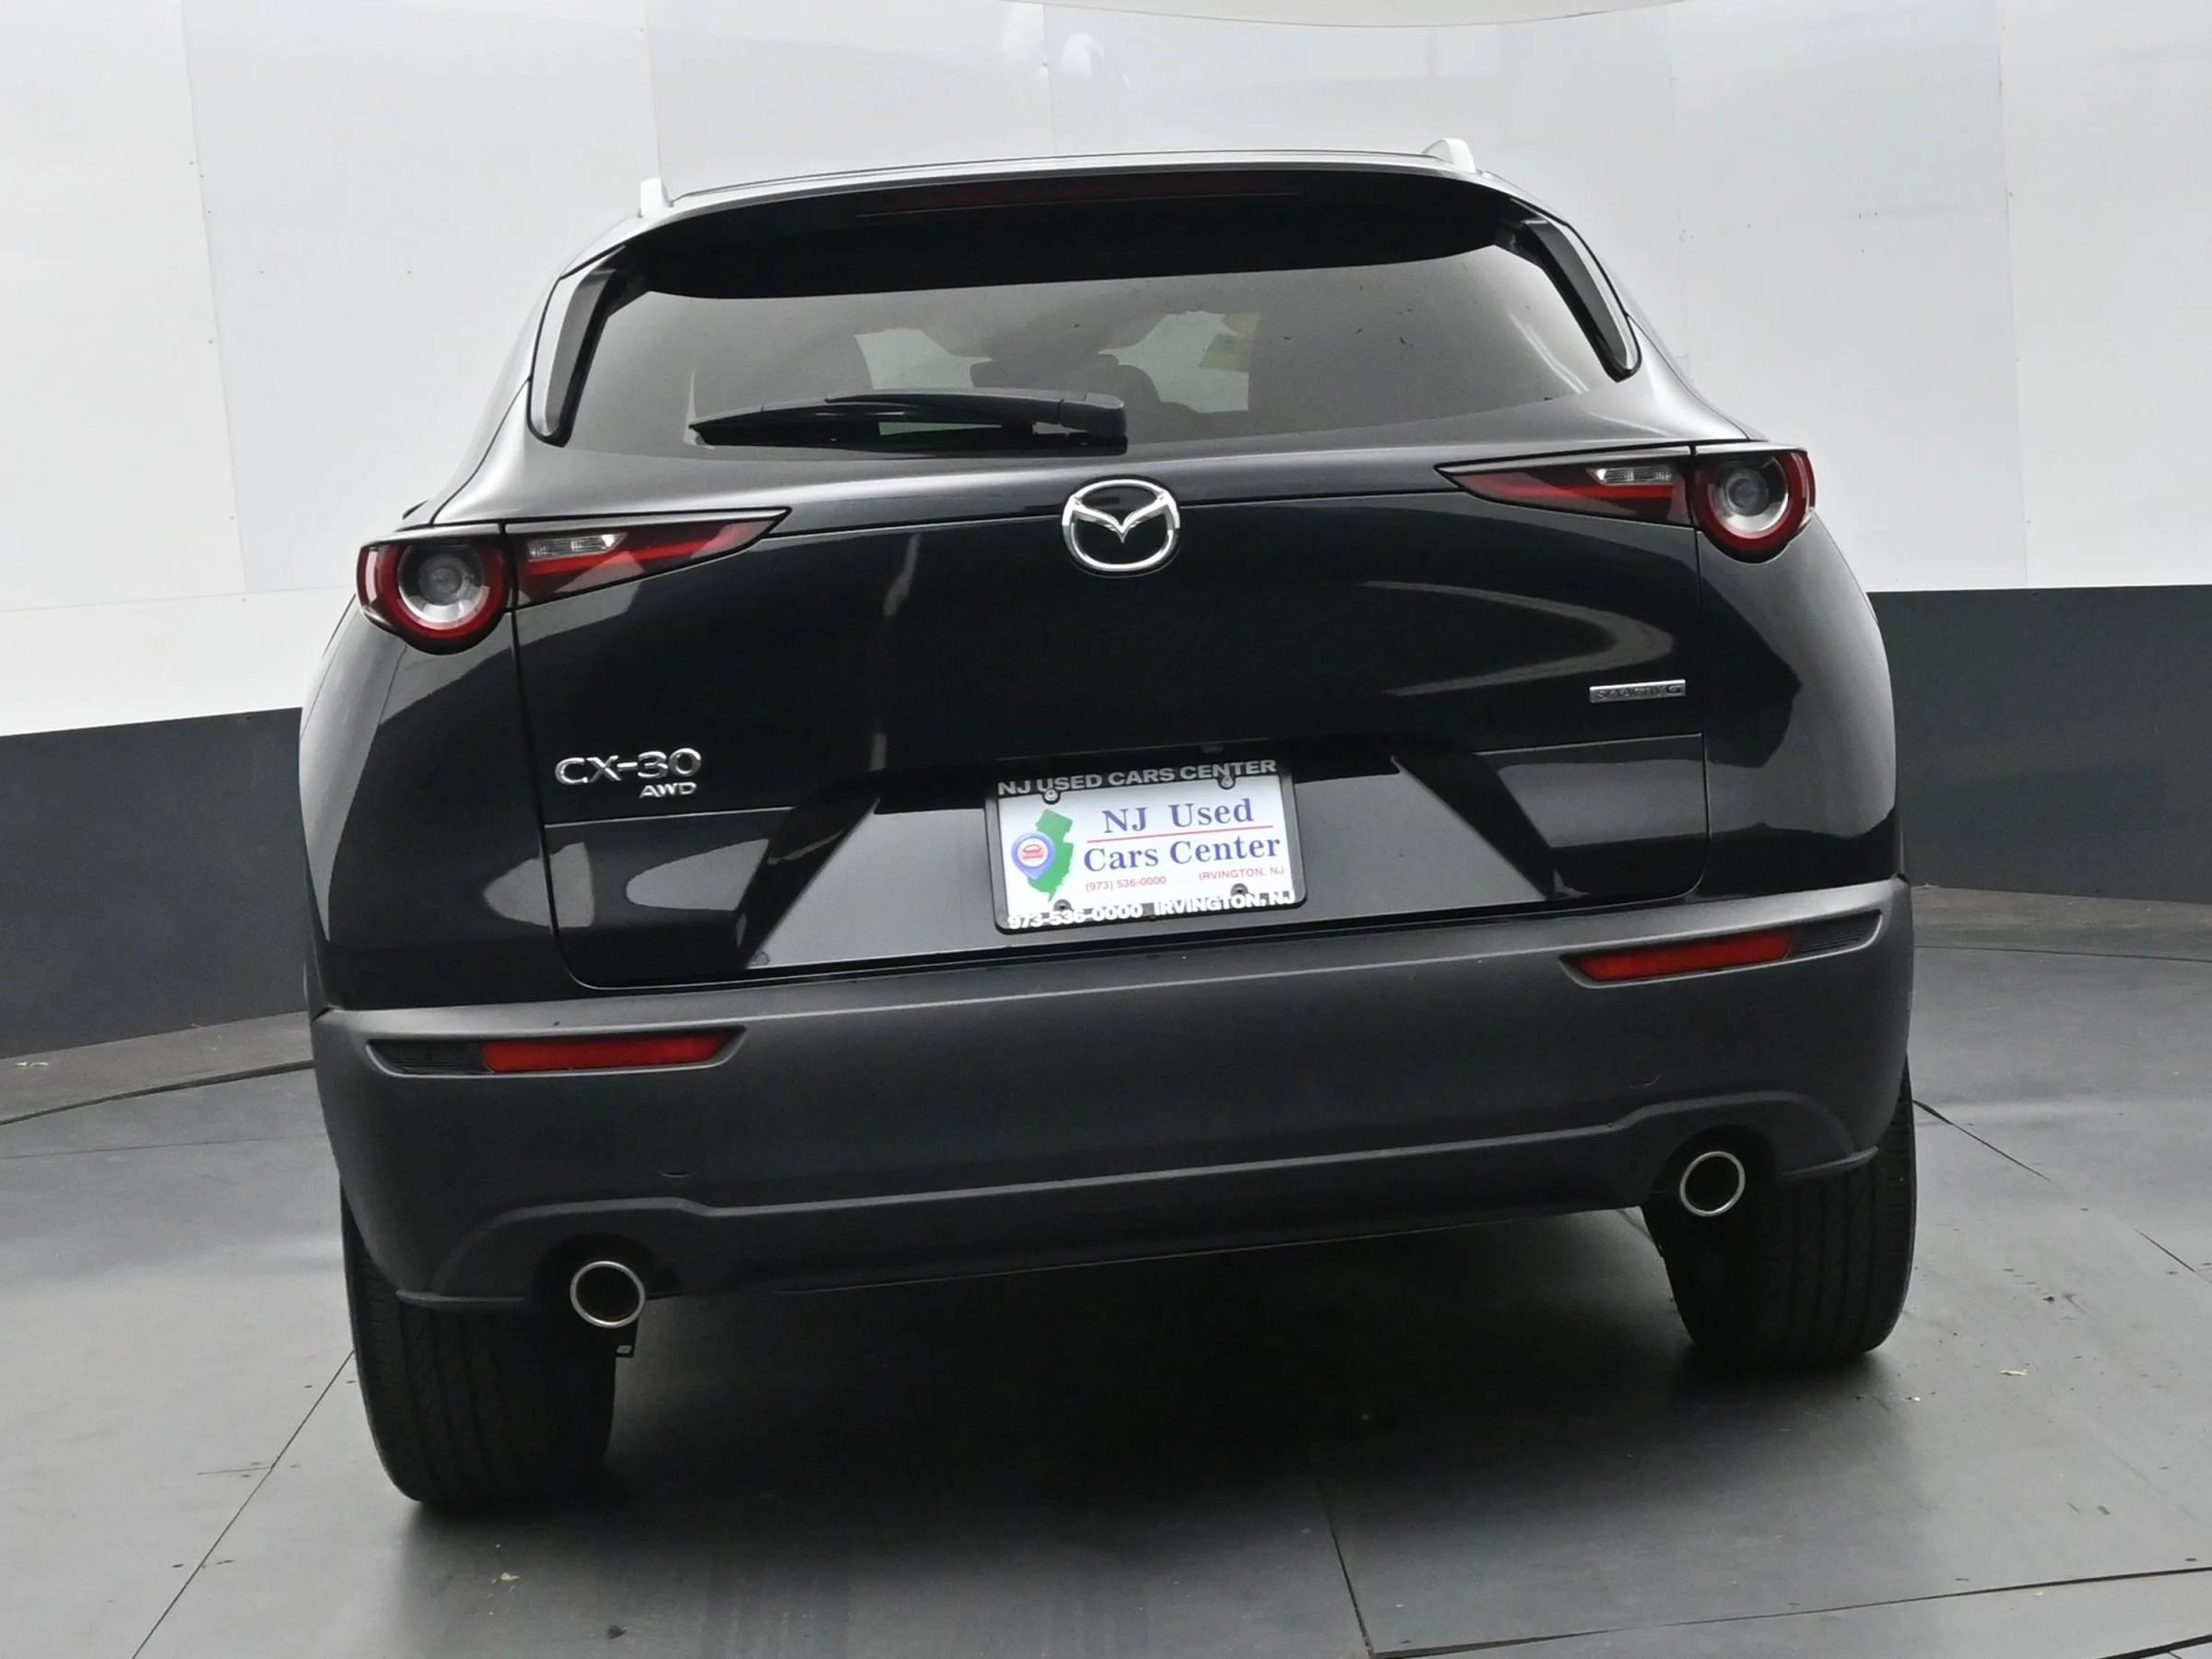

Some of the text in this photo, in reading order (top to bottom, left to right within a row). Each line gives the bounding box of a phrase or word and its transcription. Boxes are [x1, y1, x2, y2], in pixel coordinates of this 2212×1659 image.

[555, 747, 701, 785] CX-30
[997, 759, 1277, 795] NJ USED CARS CENTER
[639, 782, 698, 799] AWD
[1101, 798, 1253, 833] NJ Used
[1084, 836, 1280, 872] Cars Center
[1270, 866, 1285, 876] NJ
[1086, 876, 1167, 892] (973) 536-0000
[1007, 902, 1143, 930] 973-536-0000
[1268, 889, 1296, 905] NJ
